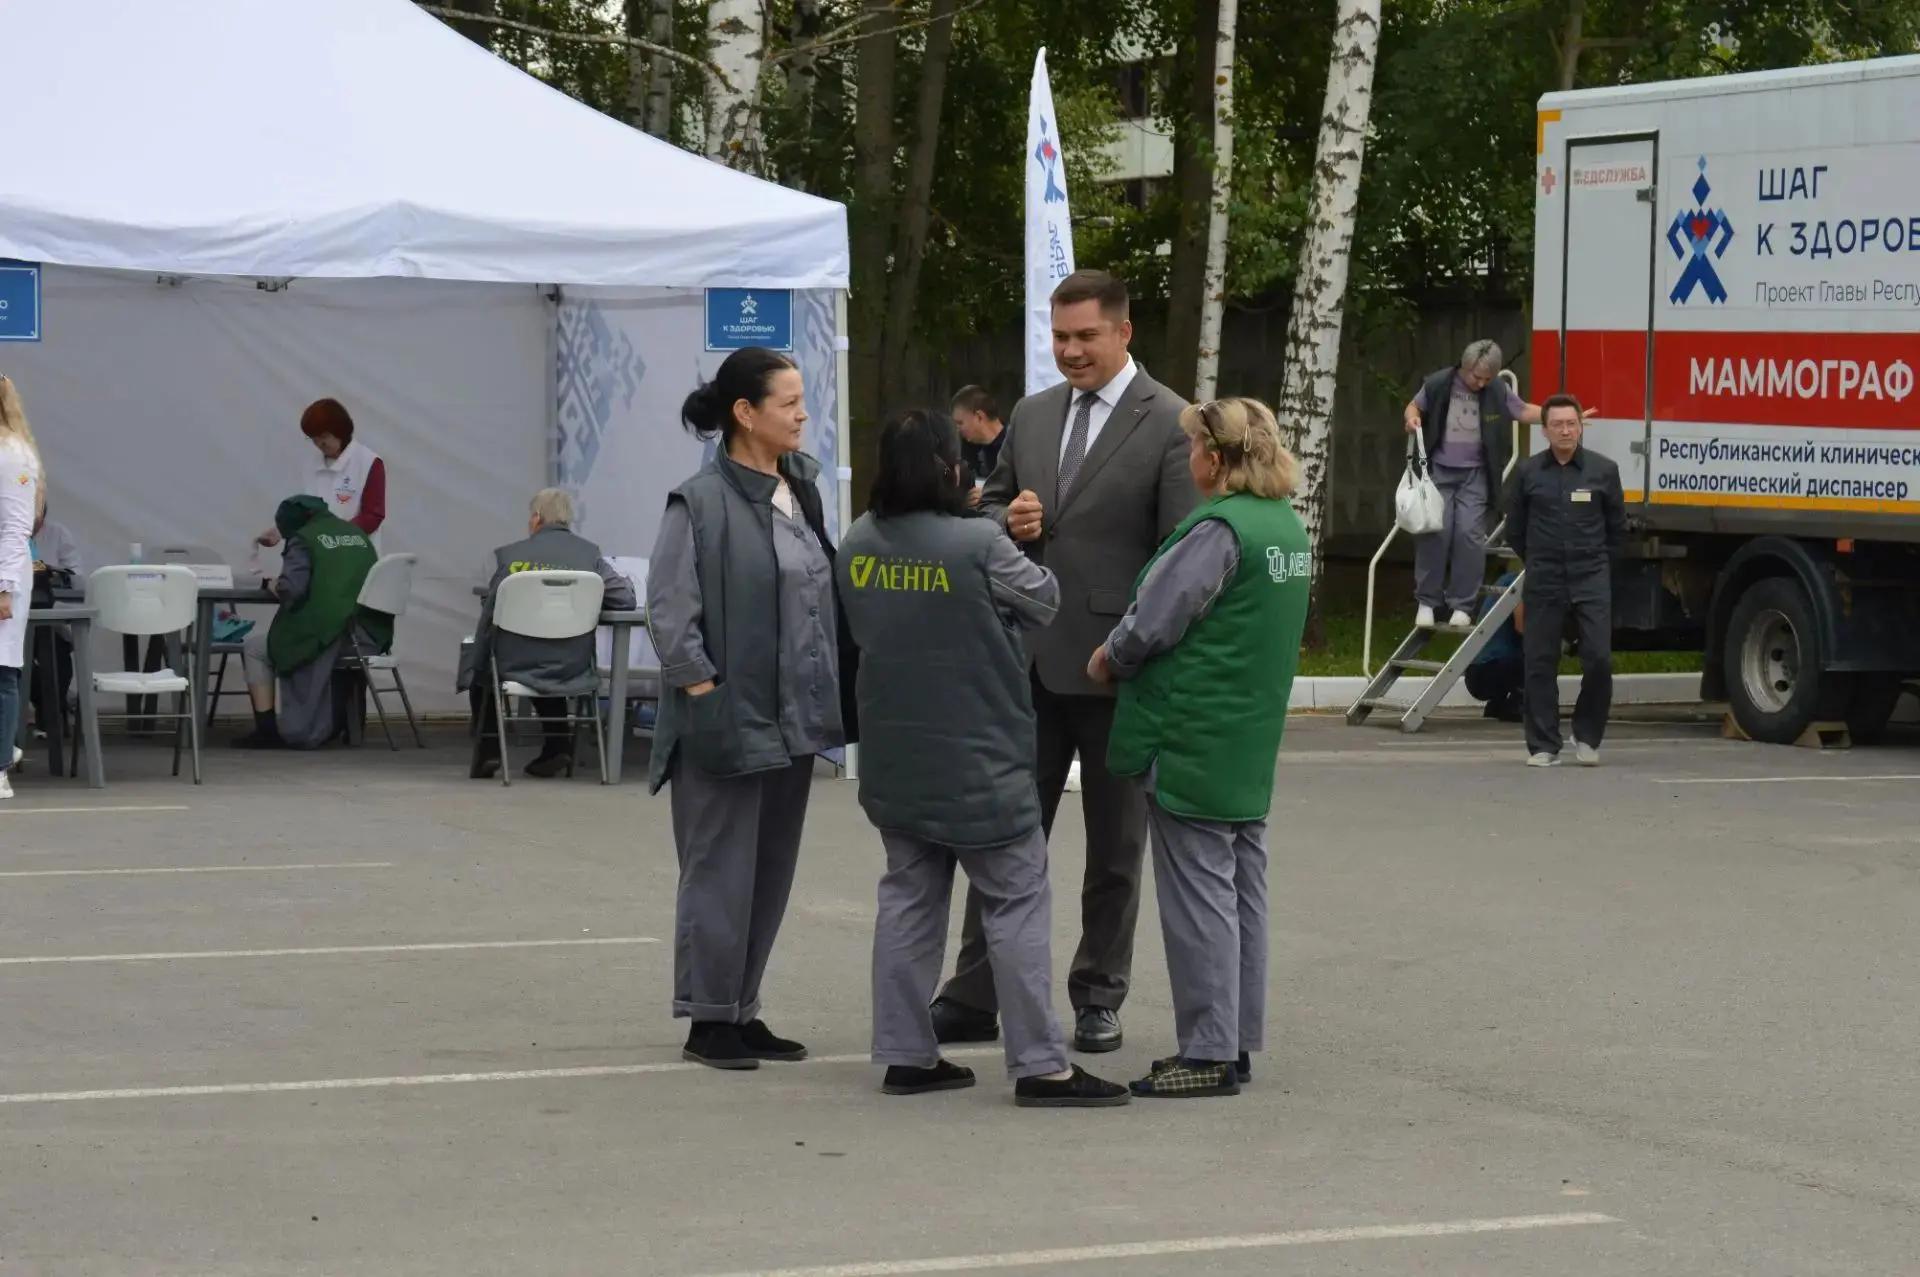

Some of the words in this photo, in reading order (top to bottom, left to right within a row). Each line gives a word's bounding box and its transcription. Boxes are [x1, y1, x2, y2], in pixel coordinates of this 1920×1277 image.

[1759, 165, 1828, 201] ШАГ
[1757, 223, 1775, 256] К
[1755, 281, 1815, 308] Проект
[1819, 280, 1867, 302] Главы
[730, 325, 775, 333] ЗДОРОВЬЮ
[1689, 357, 1914, 402] МАММОГРАФ
[1659, 438, 1815, 464] Республиканский
[1658, 472, 1801, 495] онкологический
[1806, 478, 1908, 501] диспансер
[874, 564, 949, 592] ЛЕНТА
